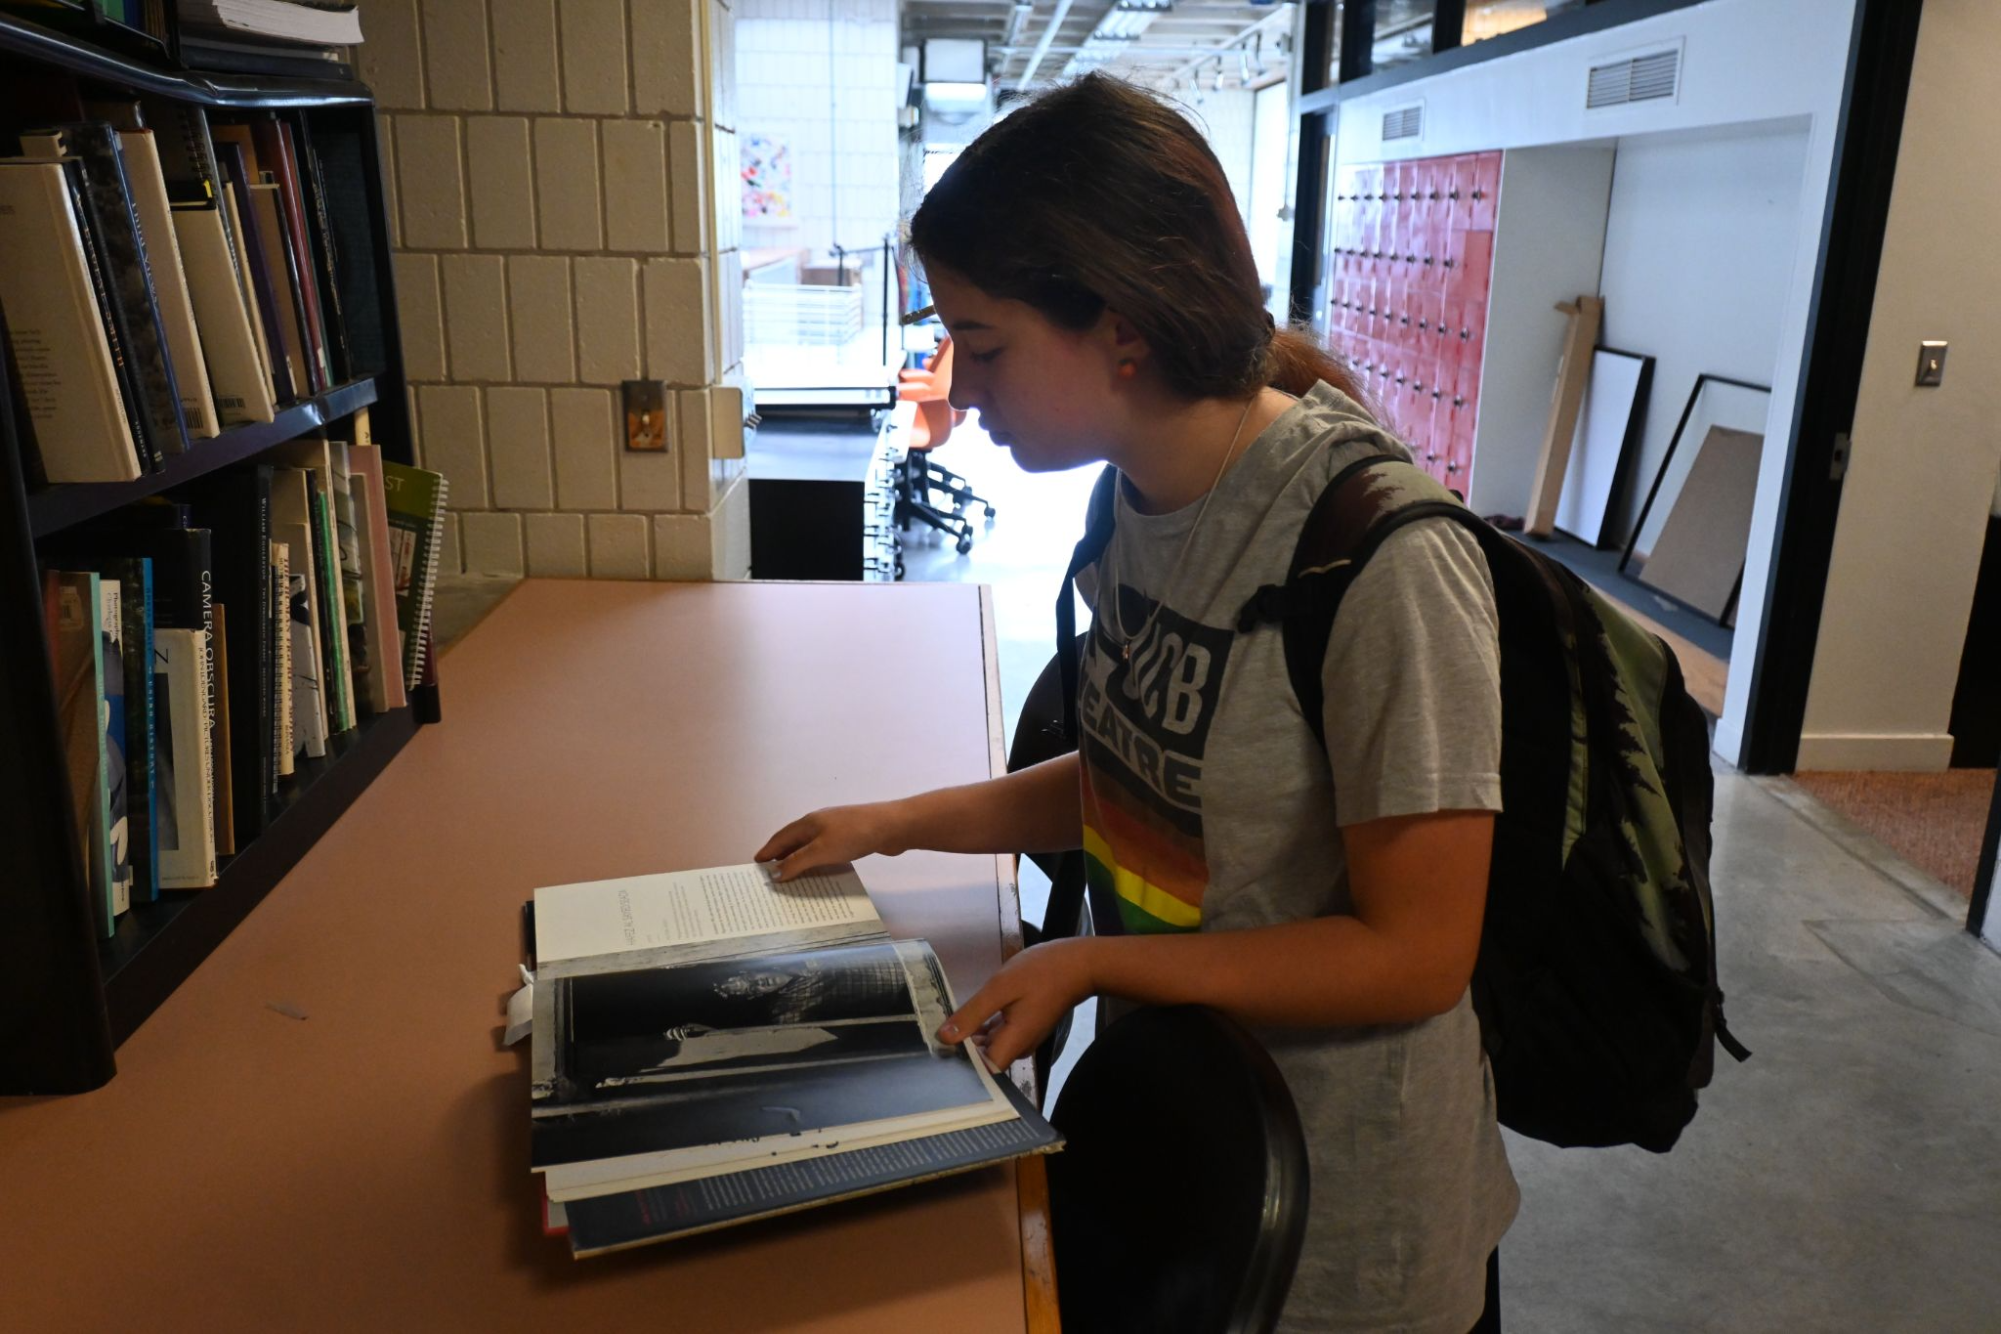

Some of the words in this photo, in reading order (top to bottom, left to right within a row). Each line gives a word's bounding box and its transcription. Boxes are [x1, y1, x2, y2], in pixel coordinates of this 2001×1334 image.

[201, 570, 213, 643] CAMERA
[206, 647, 216, 730] OBSCURA
[1083, 683, 1202, 809] EATRE
